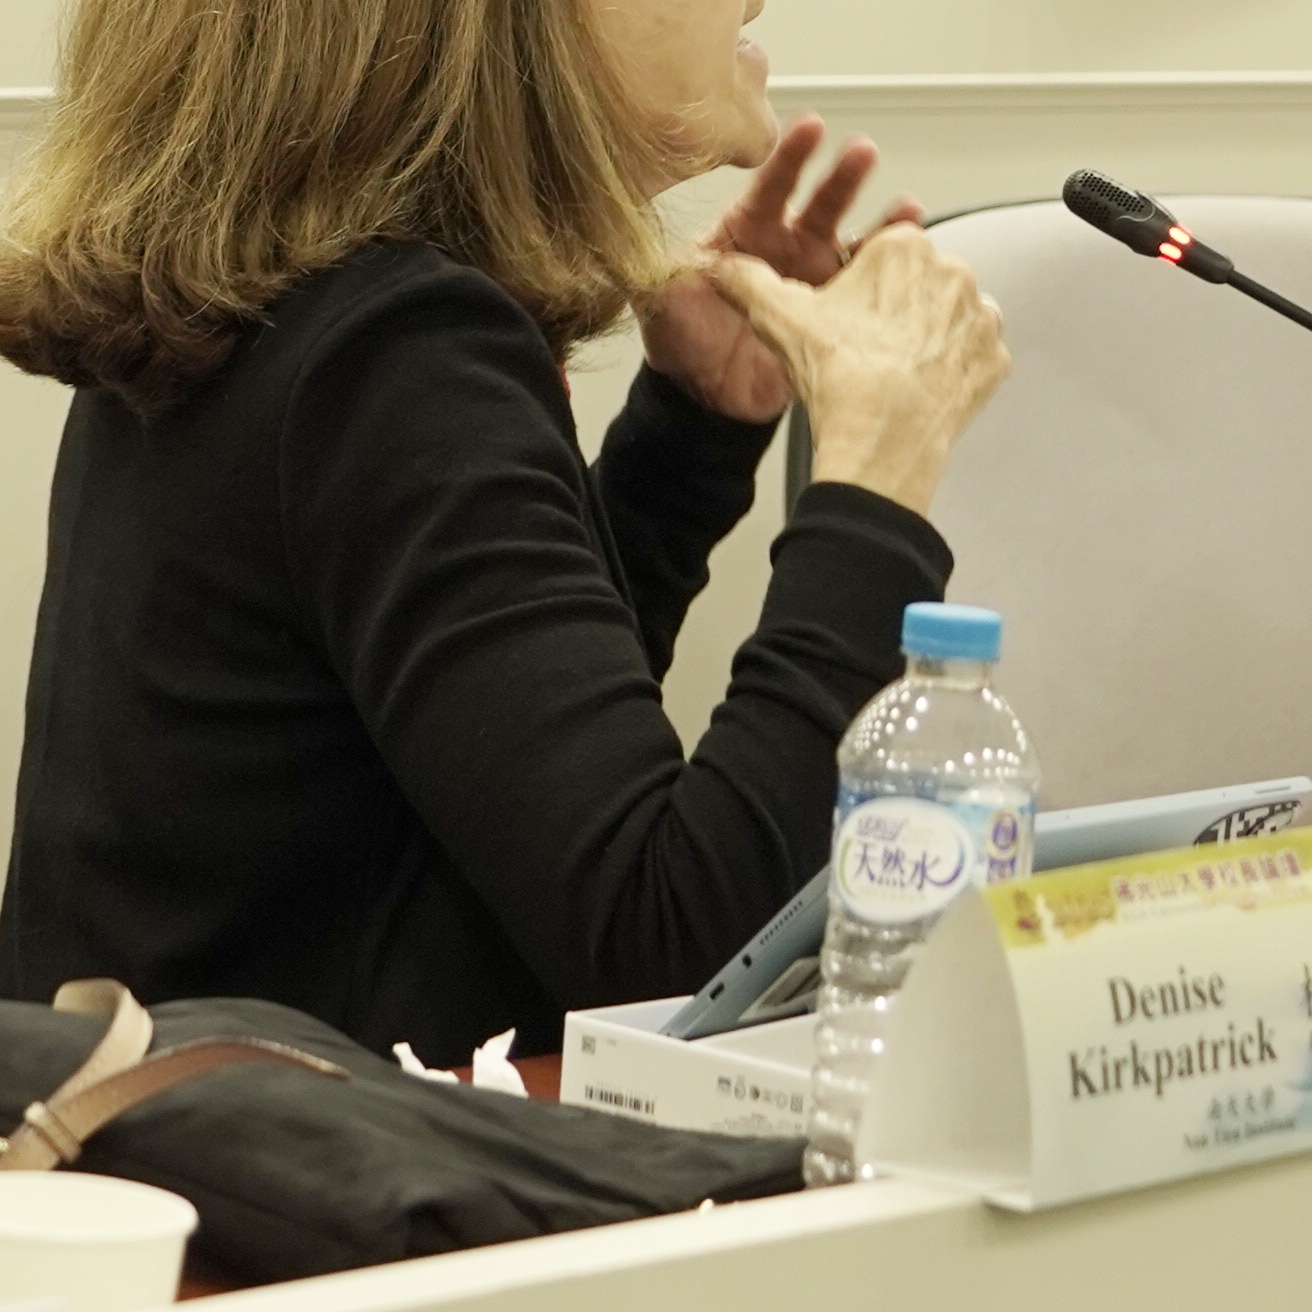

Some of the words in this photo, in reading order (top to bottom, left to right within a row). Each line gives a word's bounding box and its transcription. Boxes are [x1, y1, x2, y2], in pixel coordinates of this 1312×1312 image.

[854, 841, 941, 892] 天然水
[1106, 964, 1226, 1026] Denise
[1068, 1016, 1278, 1100] Kirkpatrick
